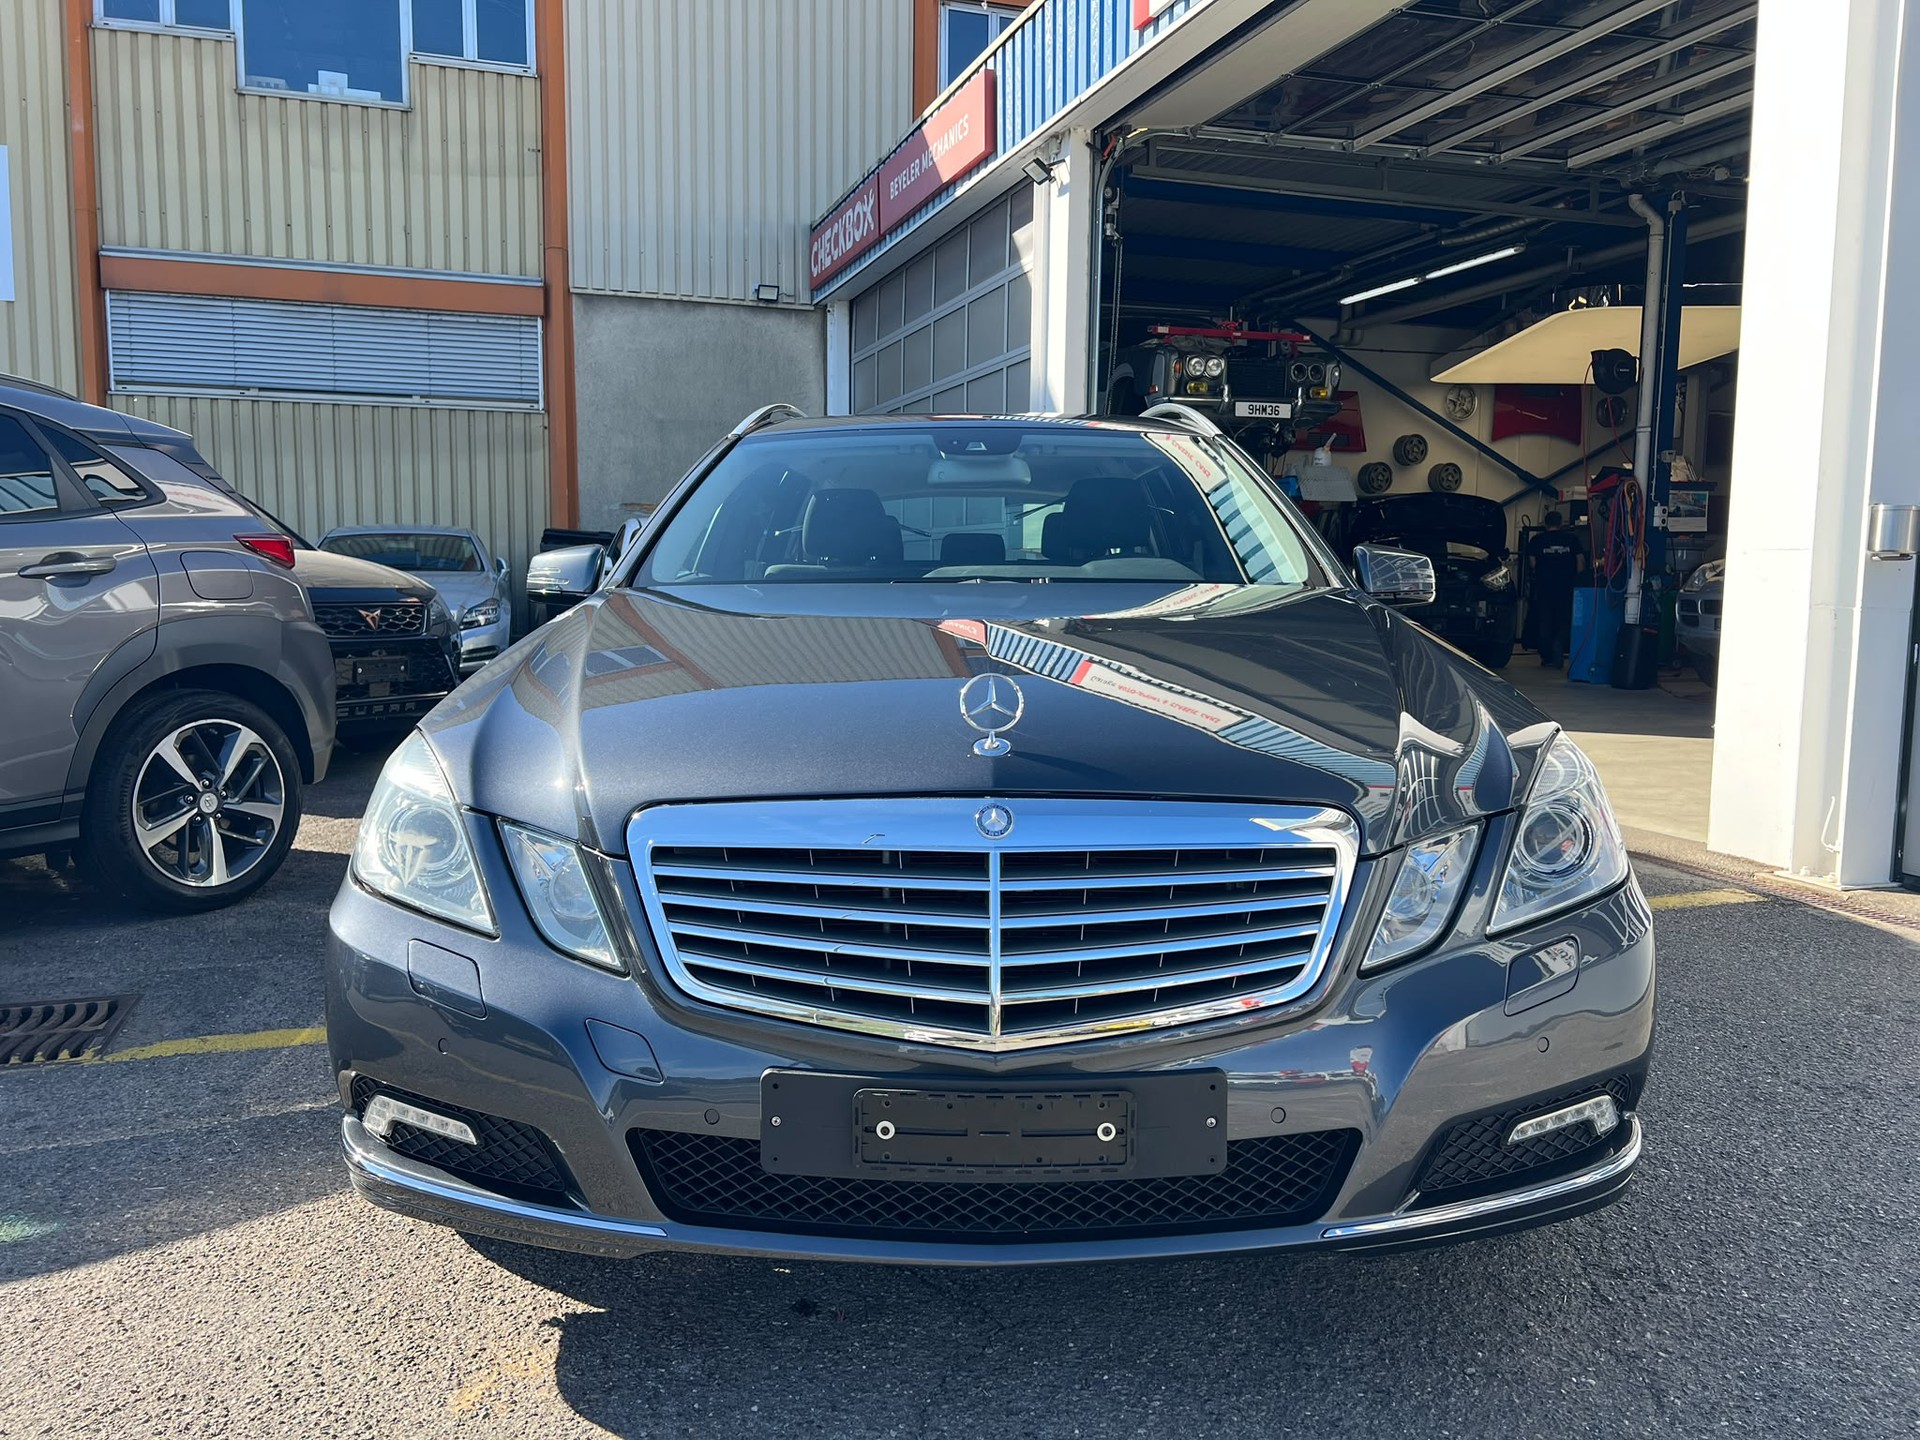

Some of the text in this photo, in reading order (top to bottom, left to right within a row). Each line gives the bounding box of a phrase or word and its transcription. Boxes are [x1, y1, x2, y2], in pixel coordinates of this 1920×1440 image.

[889, 114, 969, 200] BEYELER MECHANICS
[811, 188, 875, 278] CHECKBOX
[1247, 403, 1280, 416] 9HM36
